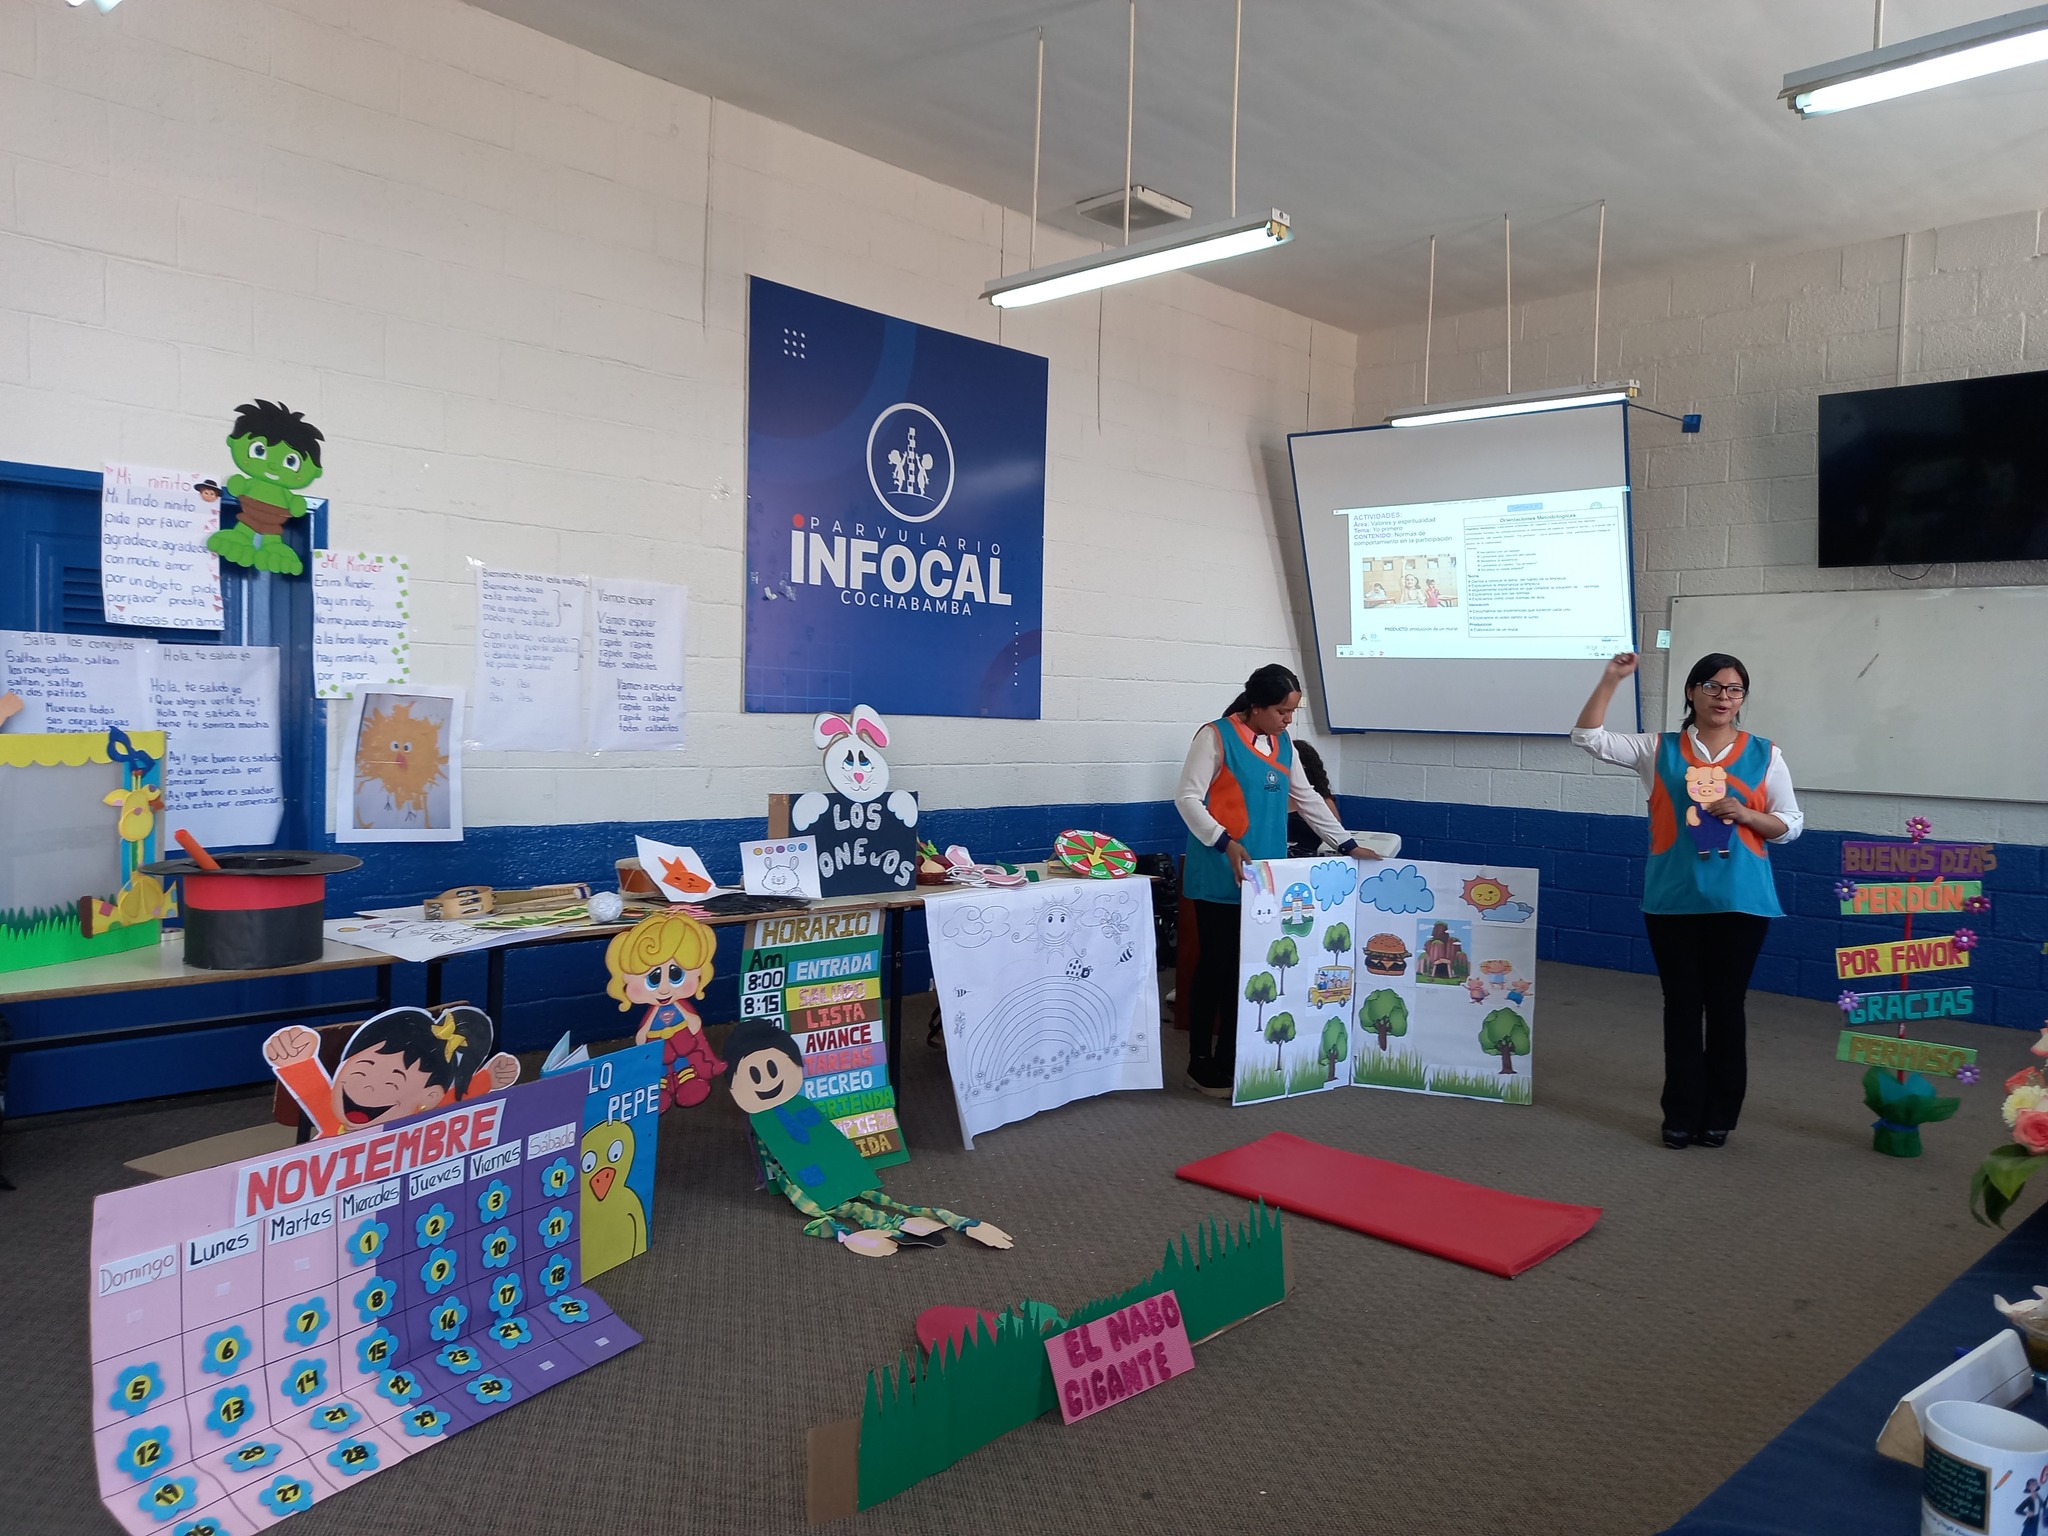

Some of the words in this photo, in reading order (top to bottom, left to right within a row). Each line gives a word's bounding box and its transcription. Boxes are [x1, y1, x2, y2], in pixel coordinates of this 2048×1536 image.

[126, 489, 158, 507] lindo
[137, 517, 157, 528] por
[810, 516, 1001, 557] PARVULARIO
[127, 556, 160, 568] mucho
[105, 573, 127, 588] por
[129, 577, 142, 586] un
[144, 576, 183, 595] objeto
[169, 596, 205, 607] presta
[841, 590, 973, 616] COCHABAMBA
[130, 615, 169, 626] cosas
[173, 617, 193, 627] con
[23, 633, 56, 646] Salta
[833, 802, 883, 831] LOS
[1844, 845, 1936, 874] BUENOS
[1939, 844, 1998, 874] DIAS
[1853, 876, 1964, 914] PERDÓN
[761, 911, 871, 946] HORARIO
[749, 950, 783, 972] Am
[795, 953, 873, 981] ENTRADA
[1838, 949, 1882, 978] POR
[1890, 940, 1963, 975] FAVOR
[748, 970, 785, 991] 8:00
[798, 981, 867, 1007] SALUDO
[743, 994, 780, 1015] 8:15
[806, 1002, 867, 1030] LISTA
[1849, 988, 1975, 1025] GRACIAS
[805, 1026, 873, 1055] AVANCE
[803, 1046, 874, 1076] TAREAS
[1848, 1037, 1967, 1077] PERMISO
[588, 1061, 613, 1094] LO
[803, 1074, 874, 1100] RECREO
[607, 1083, 660, 1126] PEPE
[855, 1133, 893, 1158] IDA
[246, 1106, 498, 1218] NOVIEMBRE
[100, 1253, 175, 1294] Domingo
[190, 1231, 249, 1266] Lunes
[270, 1206, 332, 1242] Martes
[411, 1167, 461, 1198] Jueves
[472, 1145, 522, 1178] Viernes
[530, 1127, 576, 1158] Sábado
[364, 1235, 373, 1252] 1
[431, 1219, 441, 1237] 2
[493, 1193, 502, 1209] 3
[554, 1172, 565, 1187] 4
[132, 1381, 146, 1401] 5
[222, 1341, 235, 1361] 6
[302, 1313, 317, 1332] 7
[370, 1289, 382, 1308] 8
[436, 1263, 447, 1281] 9
[490, 1239, 508, 1257] 10
[549, 1219, 563, 1235] 11
[1063, 1324, 1104, 1369] EL
[1106, 1294, 1181, 1352] NABO
[136, 1442, 161, 1467] 12
[223, 1399, 246, 1424] 13
[296, 1370, 320, 1394] 14
[368, 1343, 389, 1365] 15
[440, 1309, 459, 1330] 16
[497, 1286, 518, 1304] 17
[550, 1268, 567, 1285] 18
[1063, 1341, 1172, 1418] GIGANTE
[155, 1483, 180, 1504] 19
[238, 1446, 266, 1463] 20
[327, 1408, 350, 1423] 21
[389, 1374, 412, 1395] 22
[445, 1348, 471, 1364] 23
[500, 1322, 524, 1338] 24
[560, 1301, 584, 1315] 25
[277, 1484, 304, 1502] 27
[341, 1446, 371, 1465] 28
[413, 1410, 436, 1428] 29
[479, 1379, 504, 1394] 30
